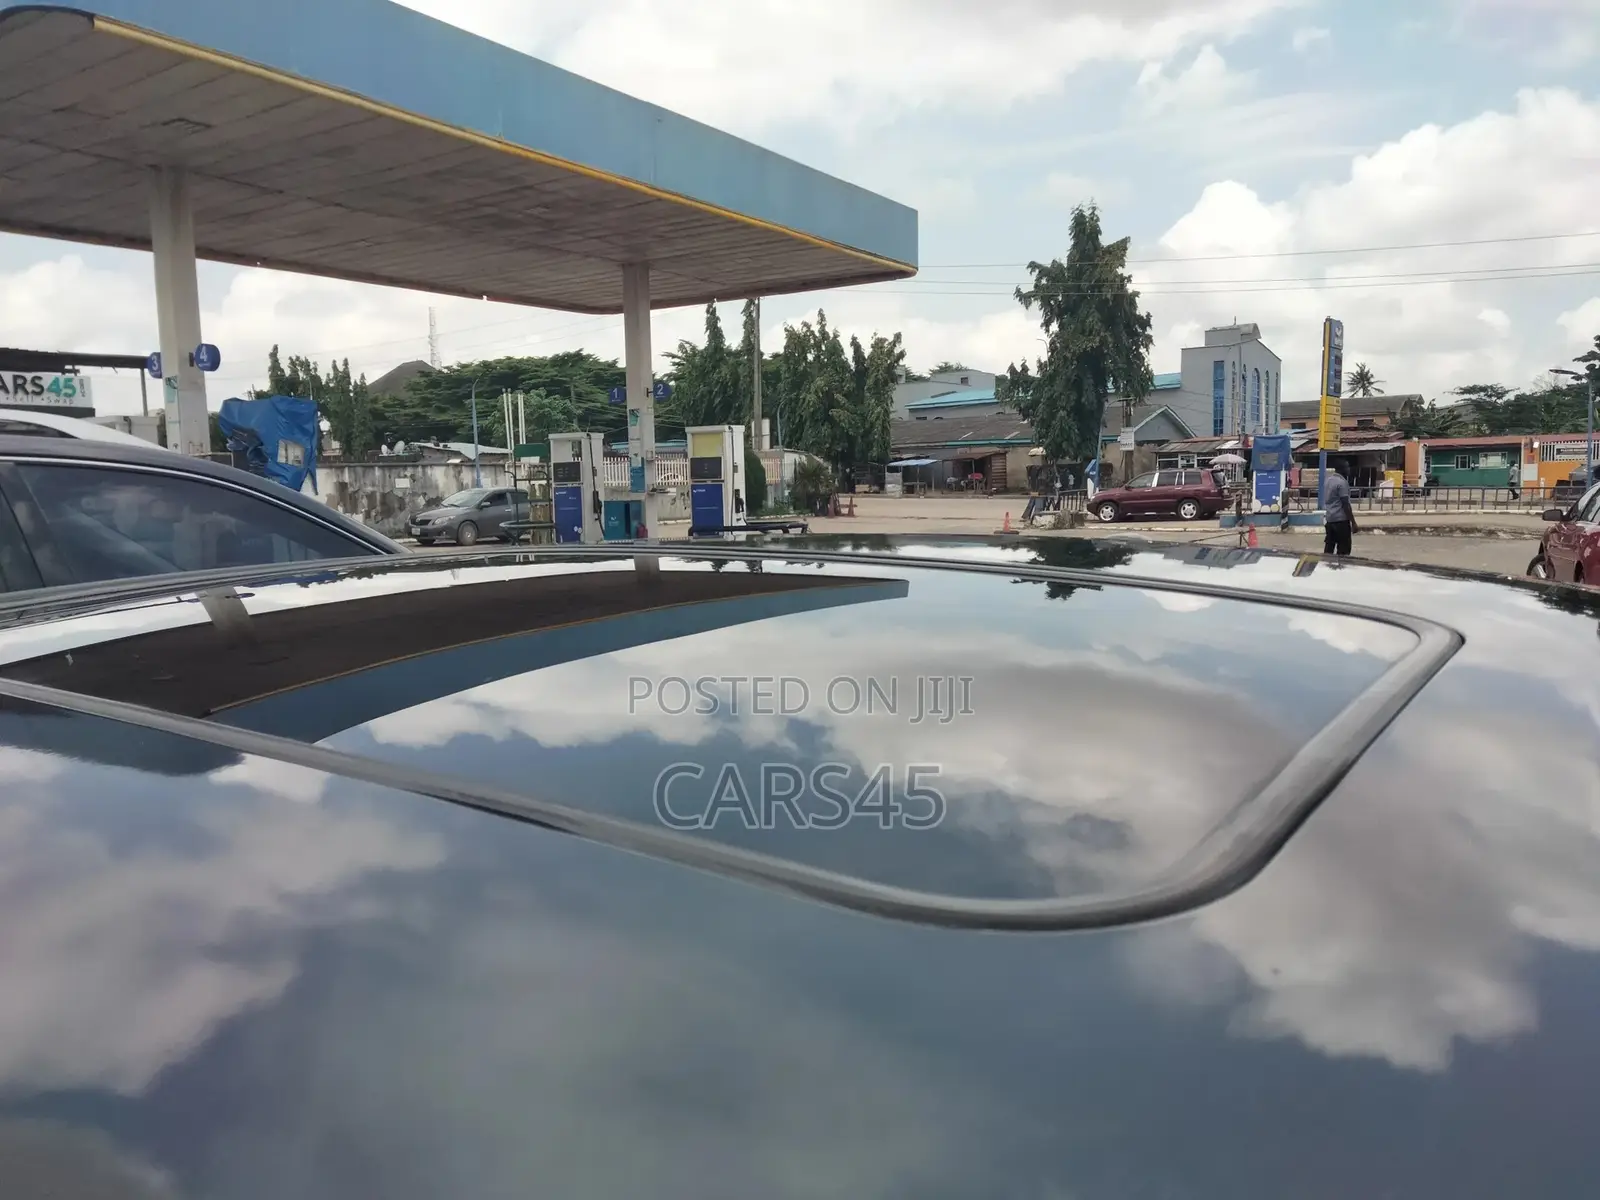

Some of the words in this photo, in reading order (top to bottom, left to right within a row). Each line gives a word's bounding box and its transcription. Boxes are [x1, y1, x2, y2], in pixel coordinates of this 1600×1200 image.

[200, 345, 208, 362] 4
[152, 354, 158, 370] 3
[656, 384, 664, 395] 2
